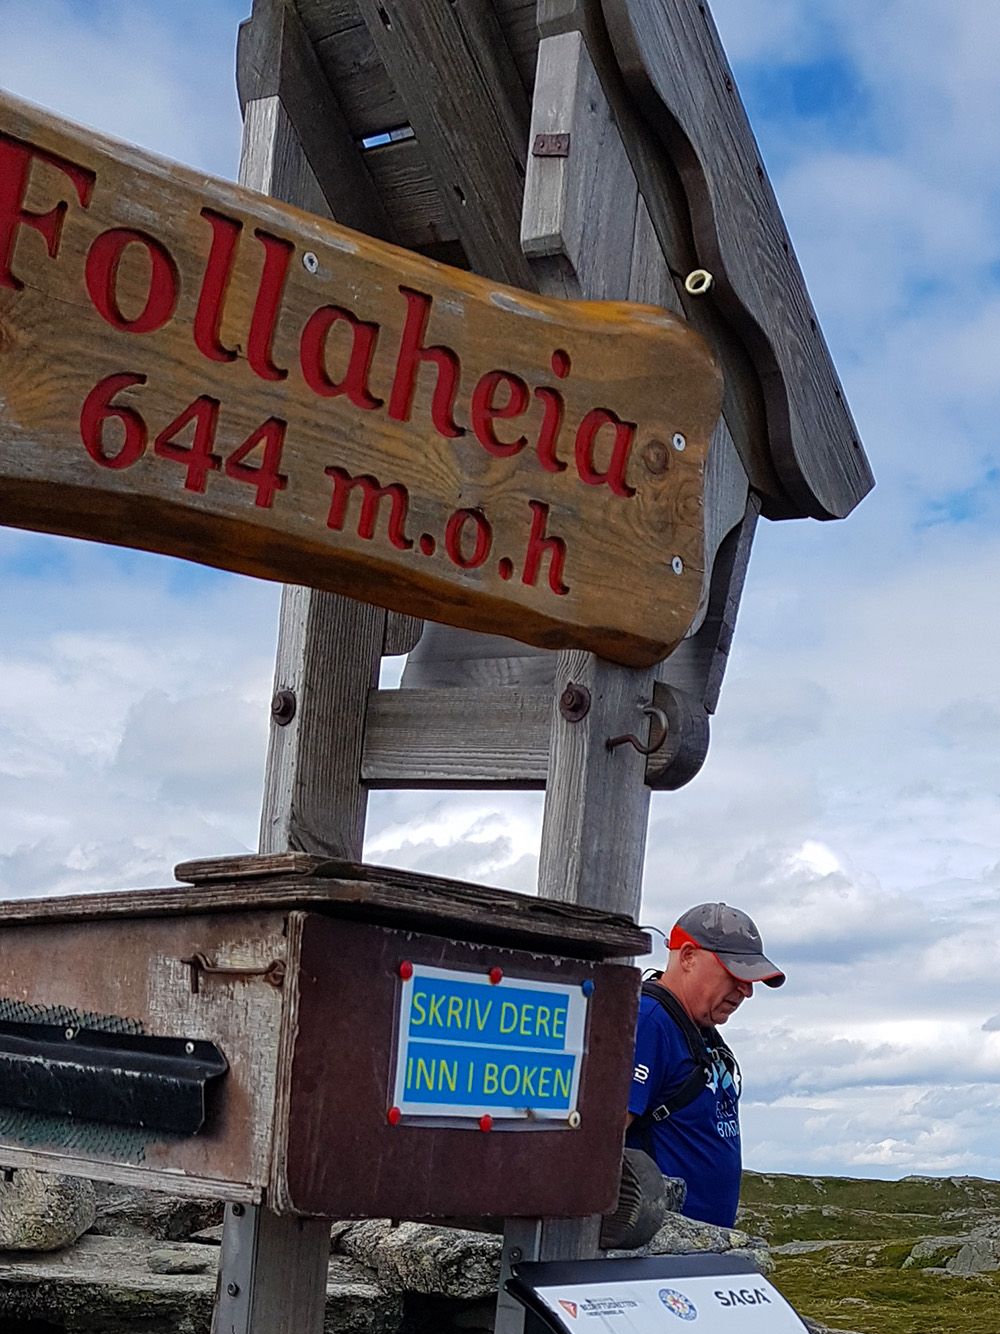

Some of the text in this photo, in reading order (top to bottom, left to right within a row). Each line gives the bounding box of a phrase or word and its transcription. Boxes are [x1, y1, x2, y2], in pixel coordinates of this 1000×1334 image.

[0, 129, 638, 498] Follaheia
[79, 371, 571, 596] 644 m.o.h
[411, 992, 567, 1039] SKRIV DERE
[406, 1057, 572, 1099] INN I BOKEN
[713, 1288, 772, 1307] SAGA
